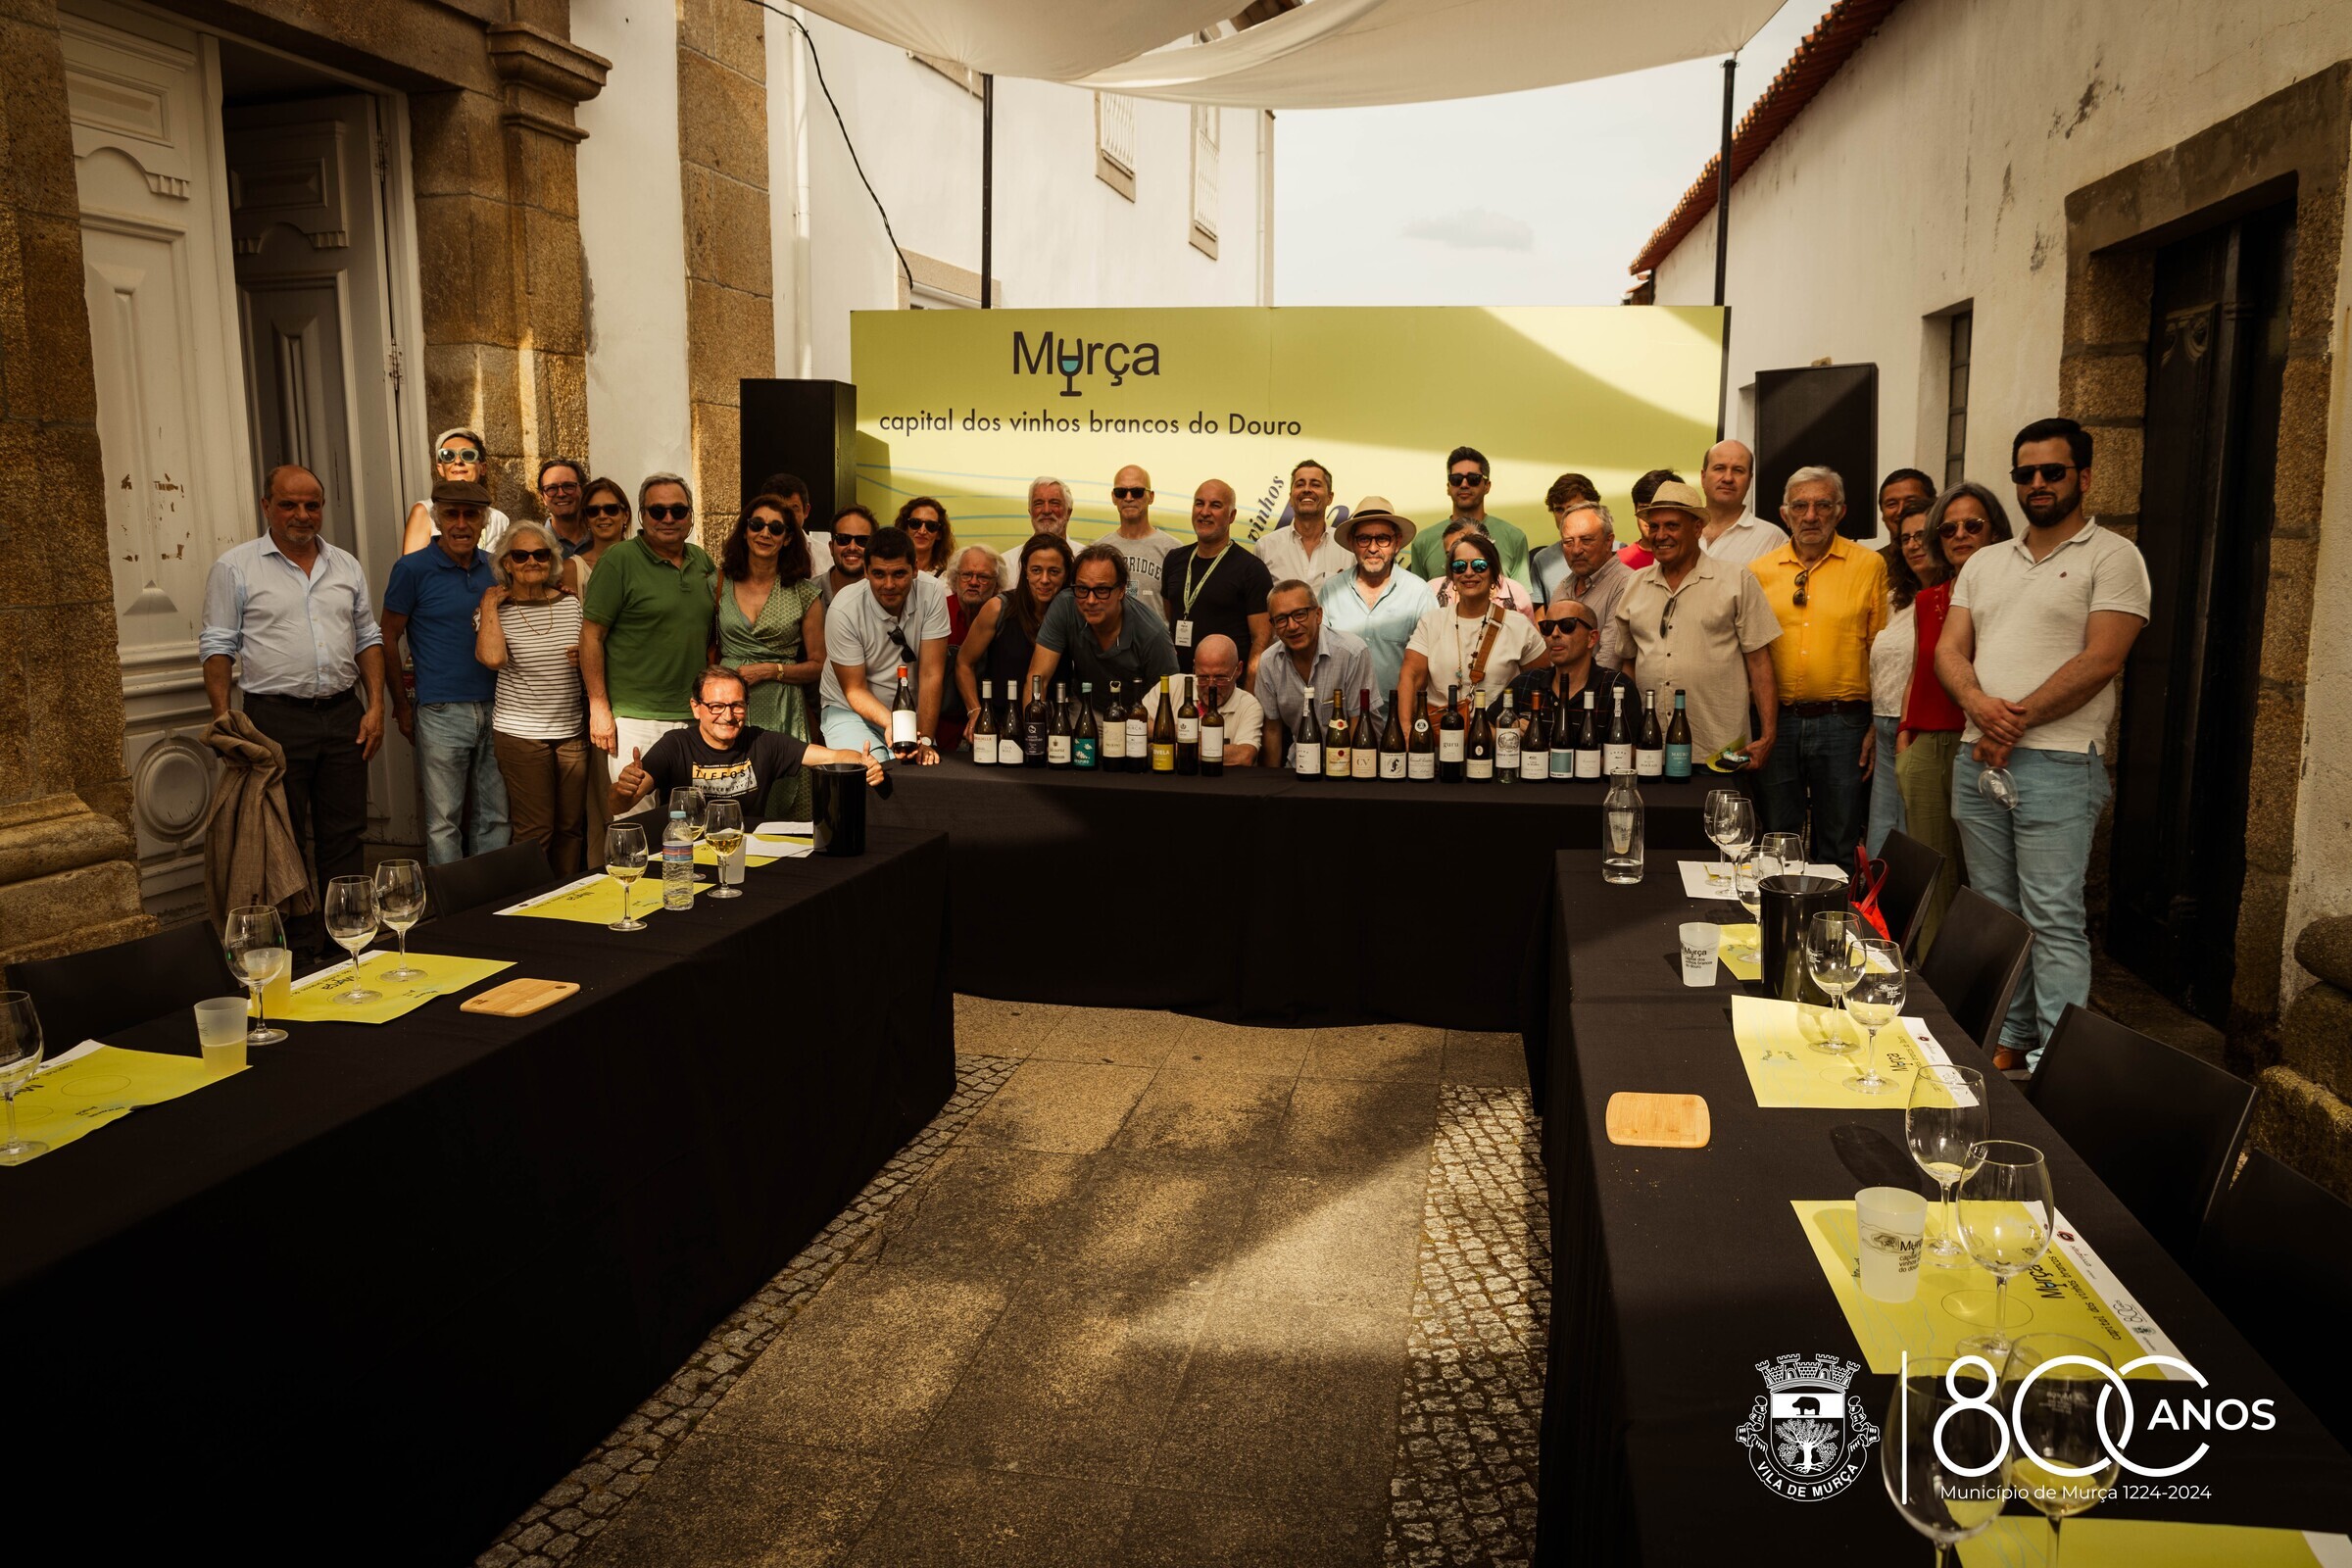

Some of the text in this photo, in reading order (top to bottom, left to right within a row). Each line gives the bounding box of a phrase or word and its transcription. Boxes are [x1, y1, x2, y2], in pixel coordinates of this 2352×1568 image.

[1012, 330, 1160, 396] Murça
[879, 409, 1301, 437] capital dos vinhos brancos do Douro
[1247, 475, 1285, 543] vinhos
